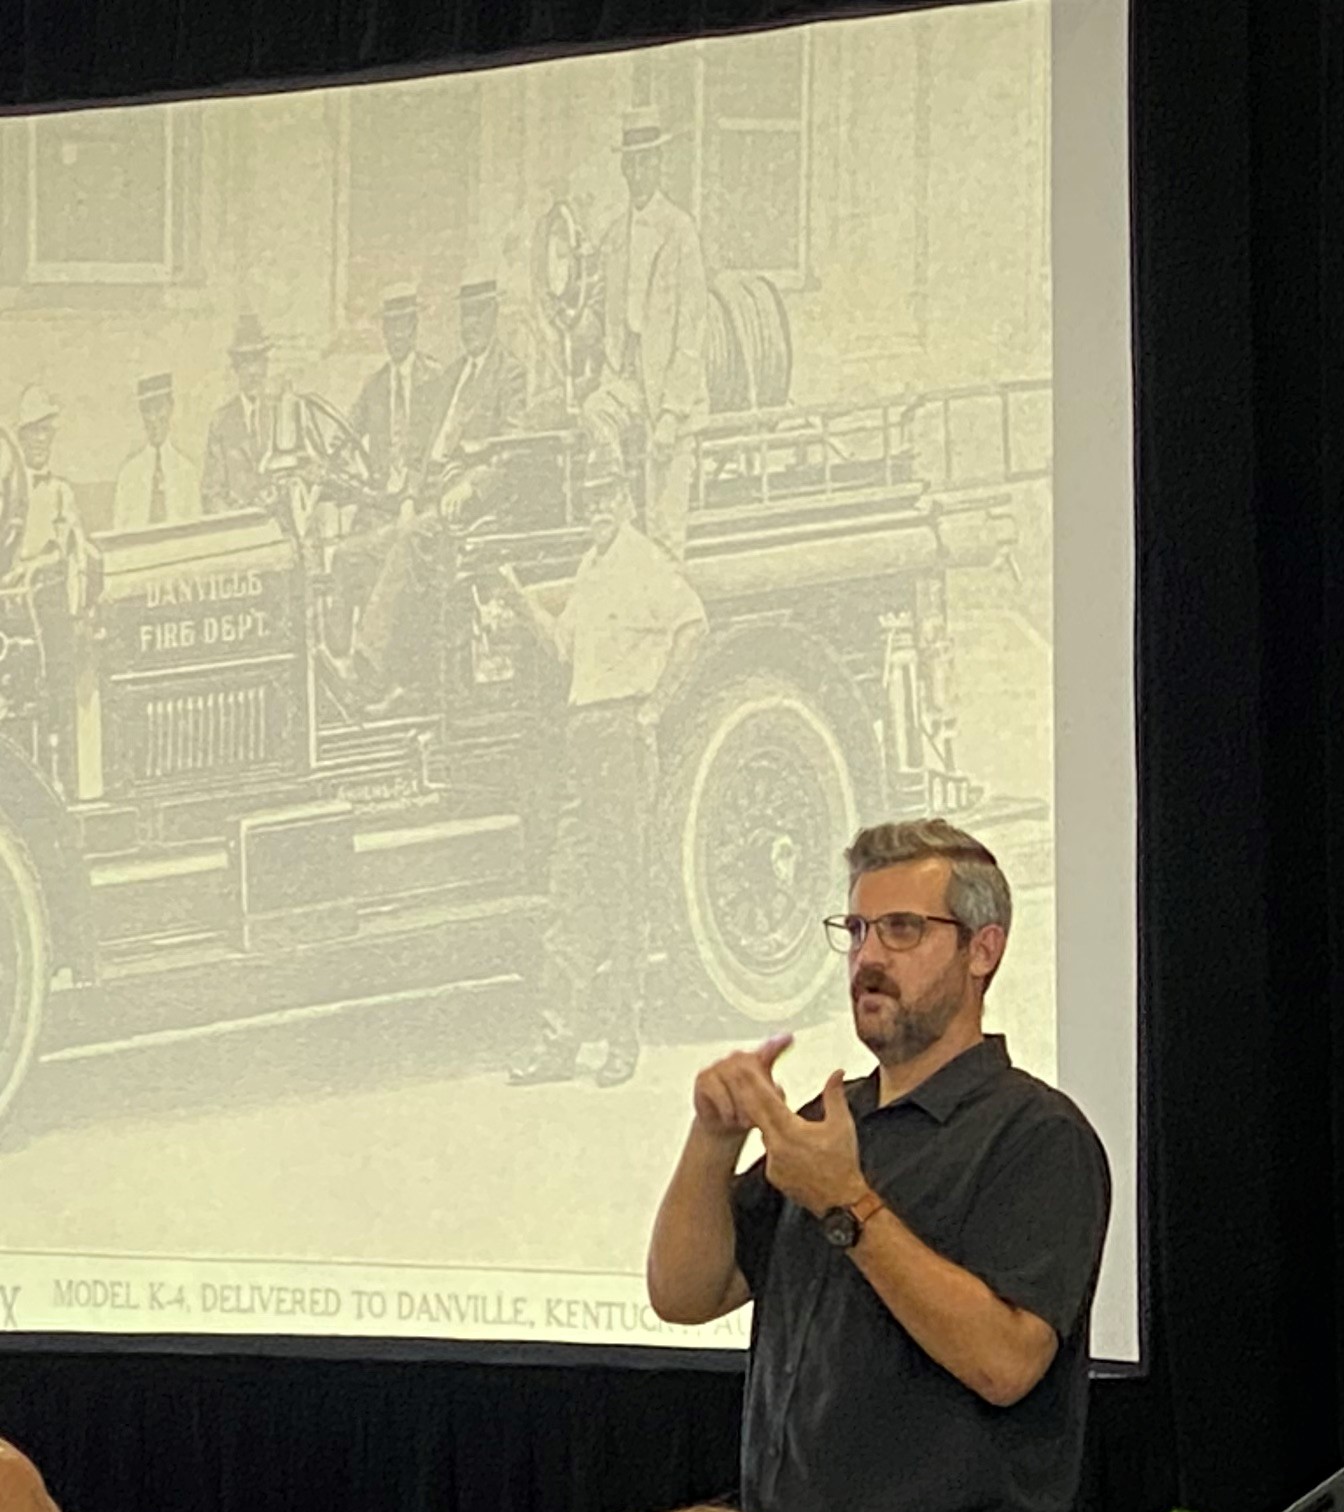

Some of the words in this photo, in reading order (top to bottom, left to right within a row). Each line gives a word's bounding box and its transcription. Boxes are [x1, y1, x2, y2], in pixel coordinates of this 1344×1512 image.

[146, 570, 263, 608] DANVILLE
[140, 620, 195, 652] FIRE
[53, 1279, 140, 1311] MODEL
[201, 1283, 341, 1318] DELIVERED
[351, 1290, 386, 1320] TO
[396, 1290, 536, 1328] DANVILLE,
